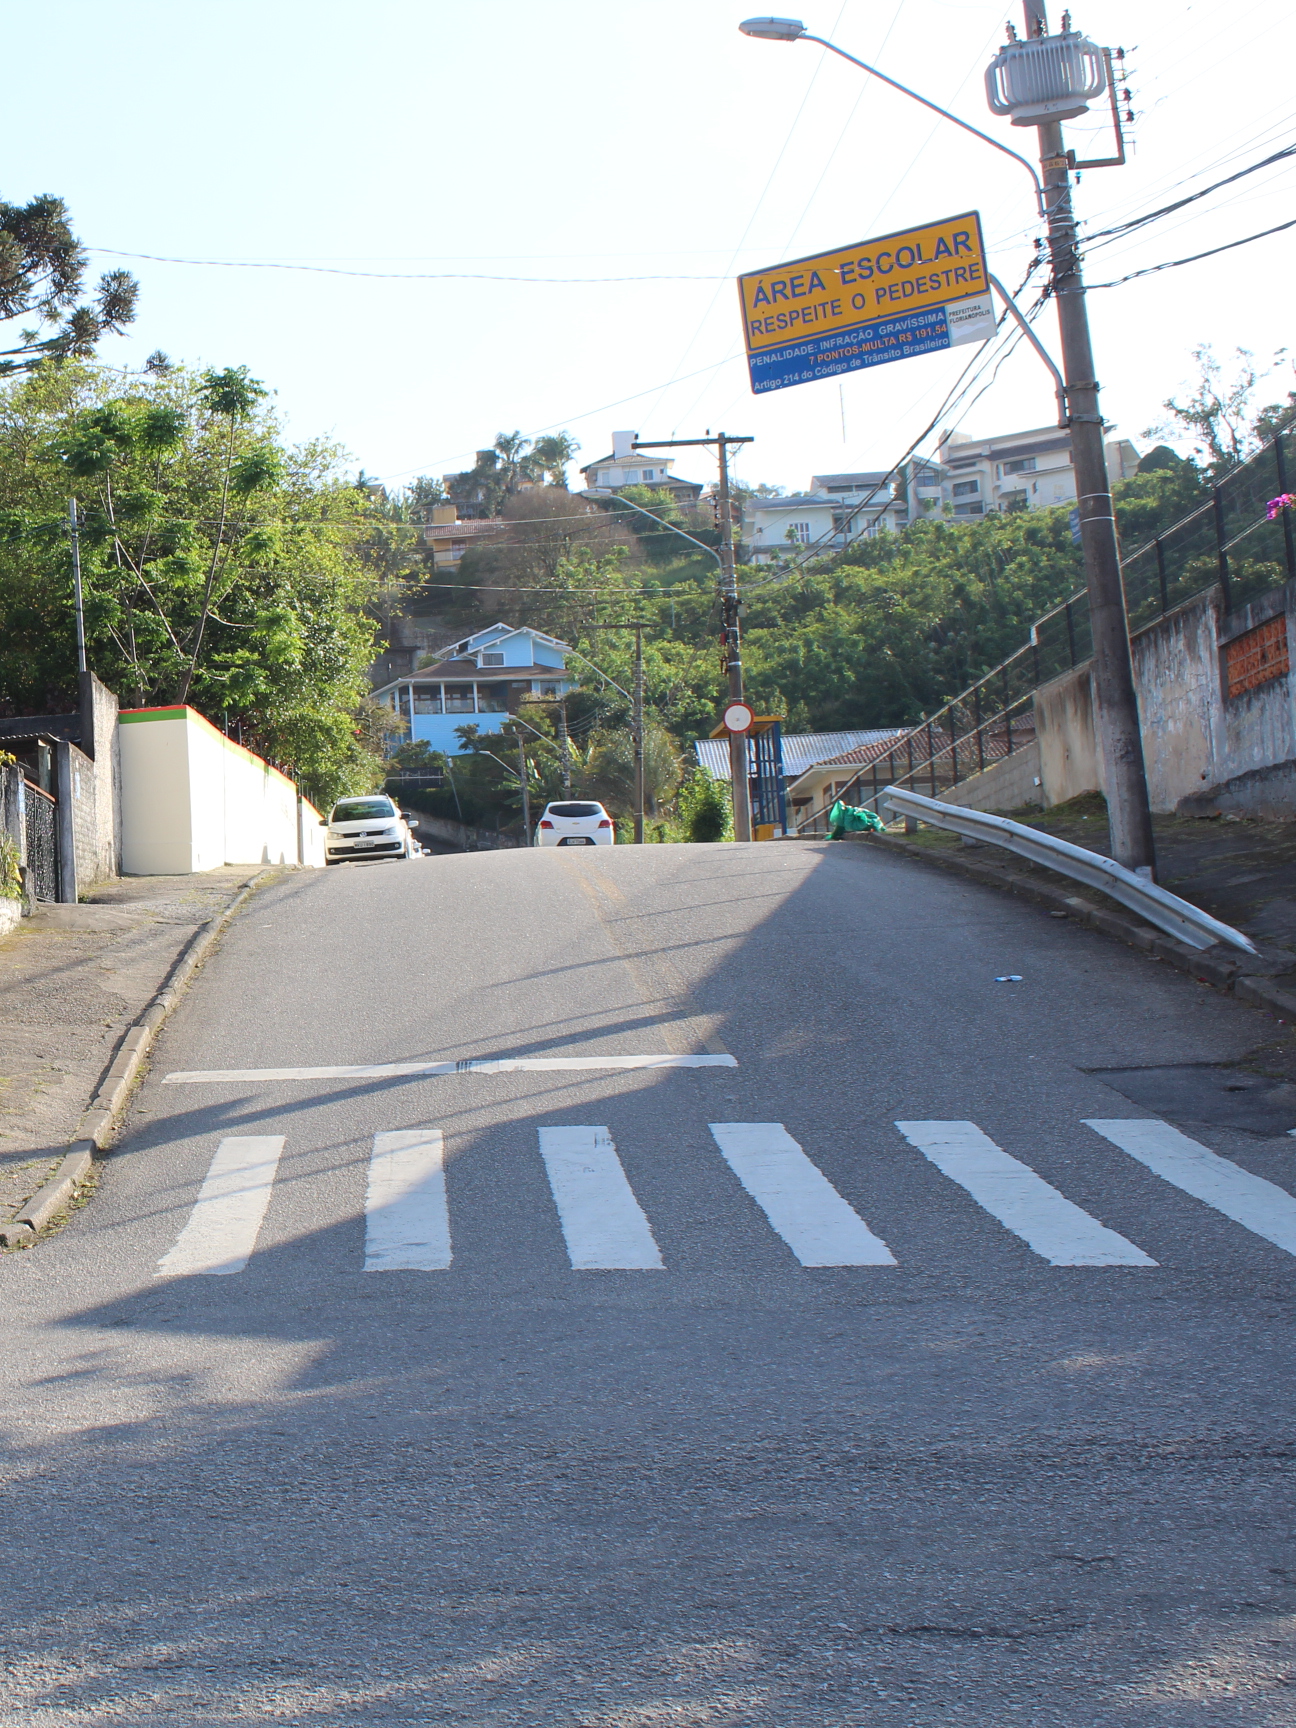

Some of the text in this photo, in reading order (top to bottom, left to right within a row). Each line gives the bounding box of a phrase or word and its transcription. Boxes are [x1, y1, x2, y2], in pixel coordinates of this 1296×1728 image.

[752, 230, 973, 308] ÁREA ESCOLAR
[750, 262, 982, 337] RESPEITE O PEDESTRE
[948, 305, 981, 317] PREFEITURA
[750, 312, 945, 367] PENALIDADE: INFRAÇÃO GRAVÍSSIMA
[754, 338, 949, 391] Artigo 214 do Código de Trânsito Brasileiro
[809, 323, 947, 365] 7 PONTOS-MULTA R$ 191,54
